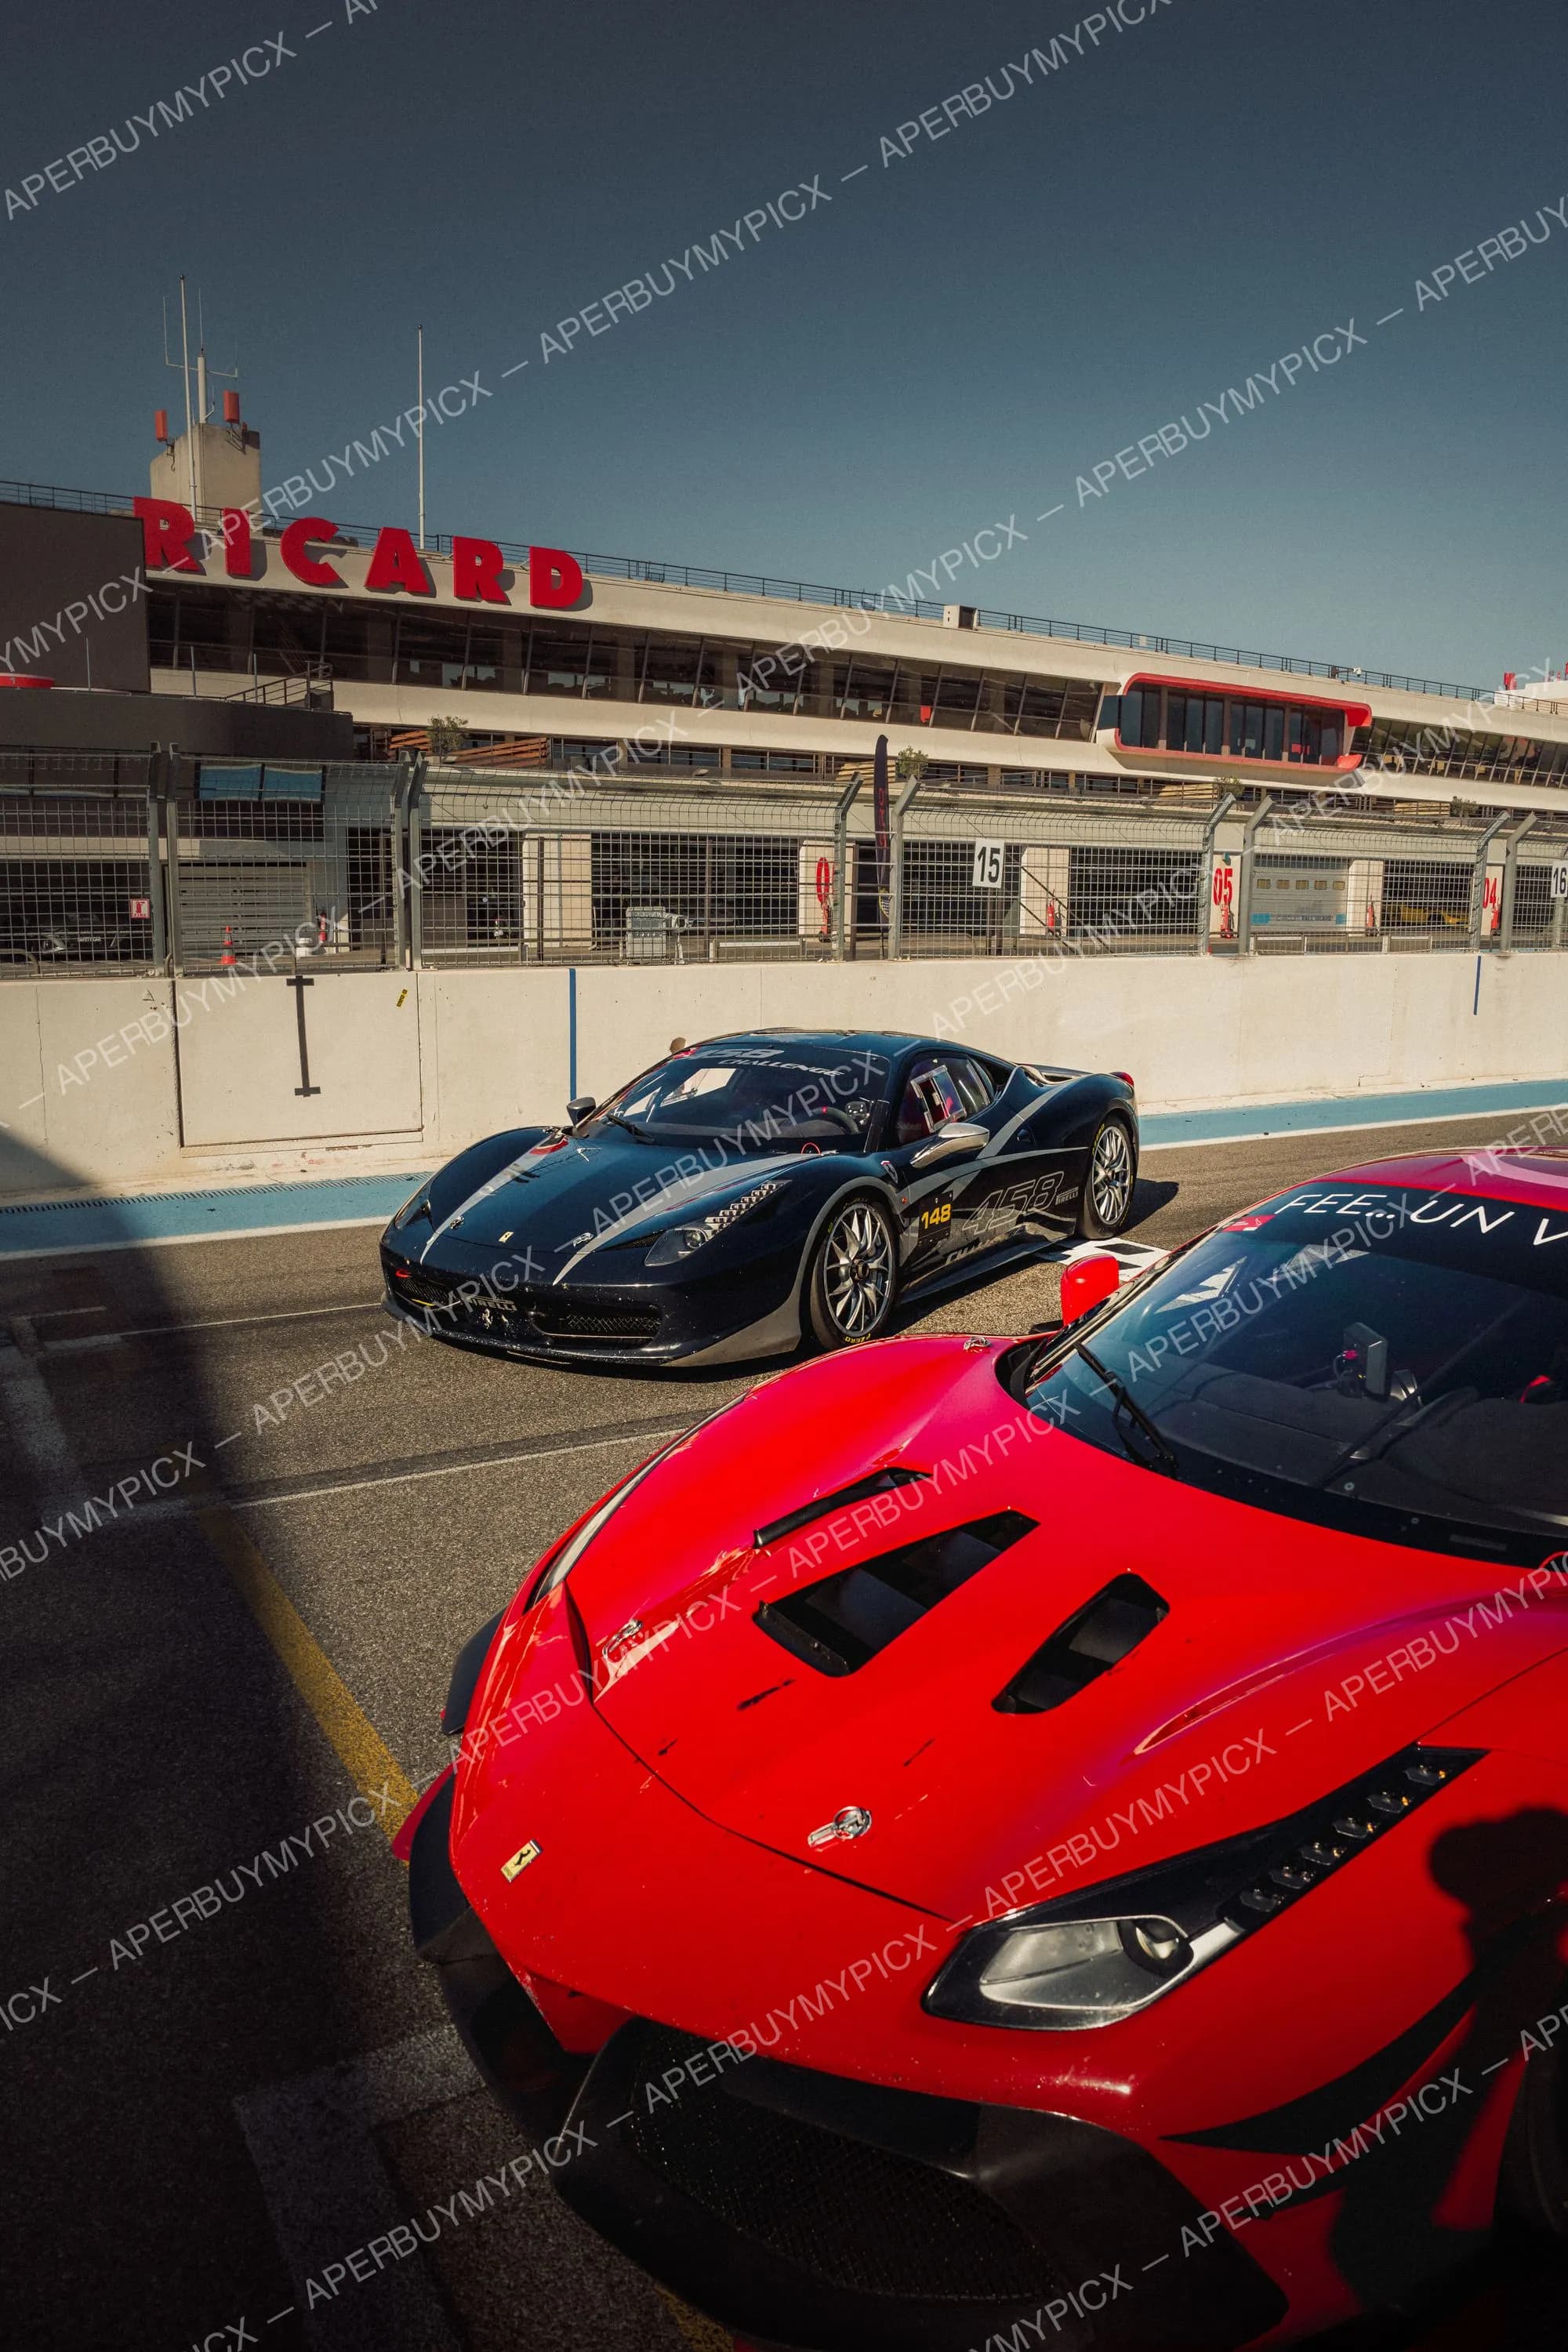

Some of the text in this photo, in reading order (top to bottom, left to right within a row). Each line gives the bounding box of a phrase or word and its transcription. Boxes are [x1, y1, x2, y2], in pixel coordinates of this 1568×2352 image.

[133, 496, 583, 609] RICARD
[978, 847, 1000, 883] 15
[1214, 868, 1232, 906] 05
[1483, 877, 1497, 909] 04
[1553, 867, 1566, 895] 16
[718, 1059, 845, 1077] CHALLENGE
[962, 1171, 1065, 1235] 458
[1055, 1187, 1079, 1206] PIRELLI
[921, 1203, 951, 1229] 148
[1410, 1200, 1515, 1234] UN
[466, 1294, 517, 1312] PIRELLI
[844, 1335, 866, 1344] ZERO
